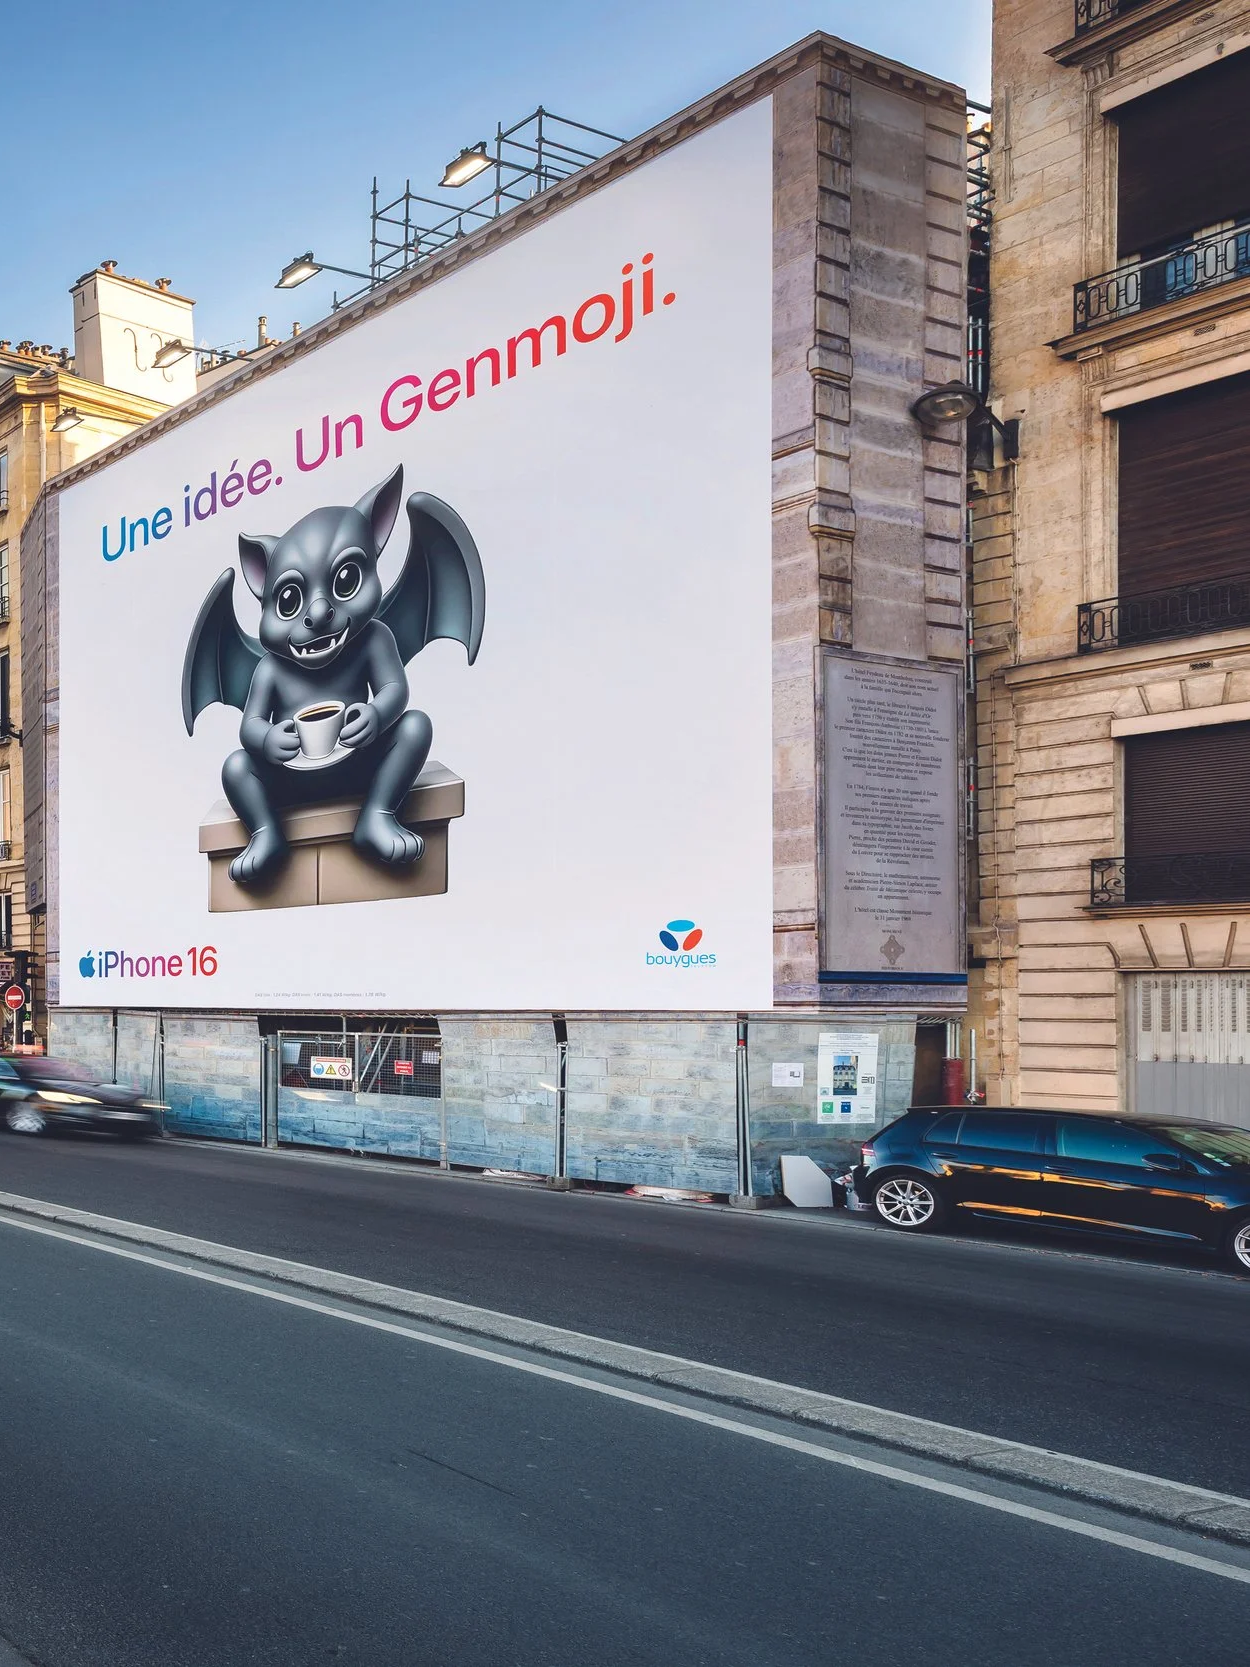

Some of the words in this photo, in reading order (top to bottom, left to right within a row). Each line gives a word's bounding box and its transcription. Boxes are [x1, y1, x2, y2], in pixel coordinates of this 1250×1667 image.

[102, 506, 173, 562] Une
[183, 459, 283, 528] idée.
[295, 414, 363, 472] Un
[380, 252, 677, 432] Genmoji.
[98, 950, 183, 978] iPhone
[187, 945, 218, 976] 16
[646, 952, 716, 968] bouygues
